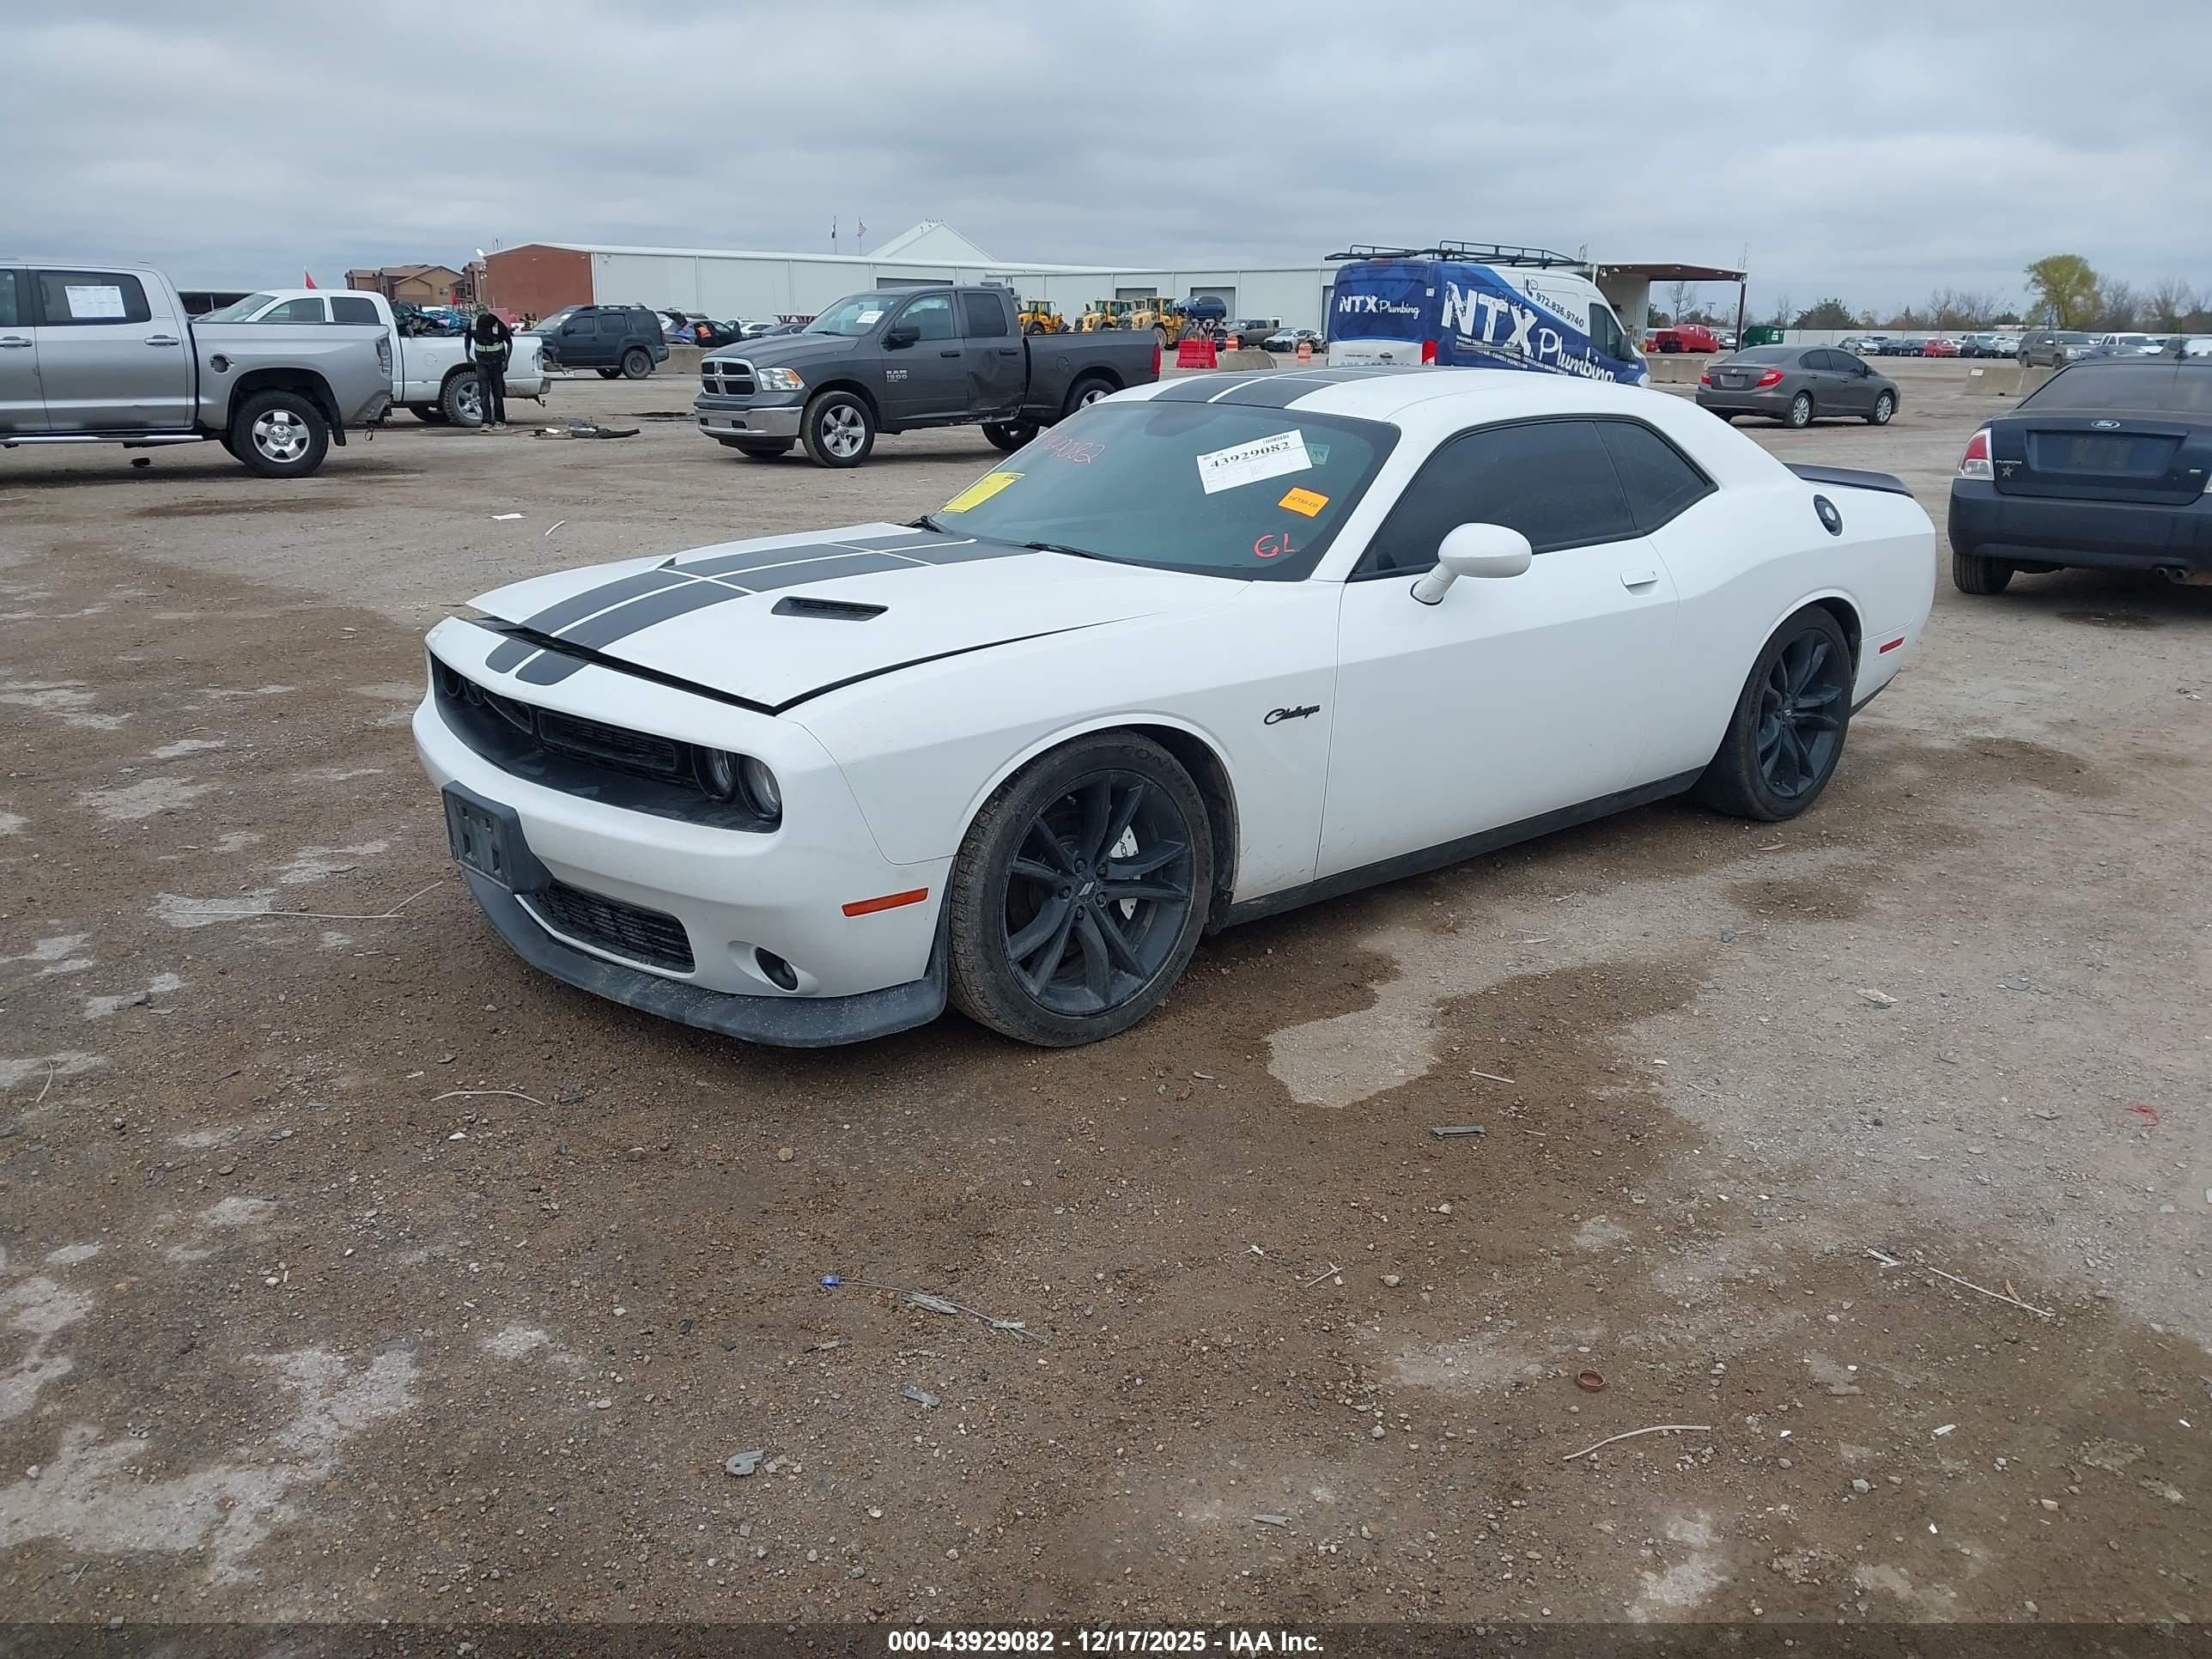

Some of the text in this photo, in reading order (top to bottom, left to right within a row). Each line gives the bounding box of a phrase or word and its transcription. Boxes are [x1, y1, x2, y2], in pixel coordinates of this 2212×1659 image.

[1339, 294, 1421, 320] NTX Plumbing
[1441, 281, 1539, 356] NTX
[1535, 293, 1585, 328] 972.836.9740
[1210, 441, 1291, 468] 43929082
[1288, 495, 1319, 508] DETAILED
